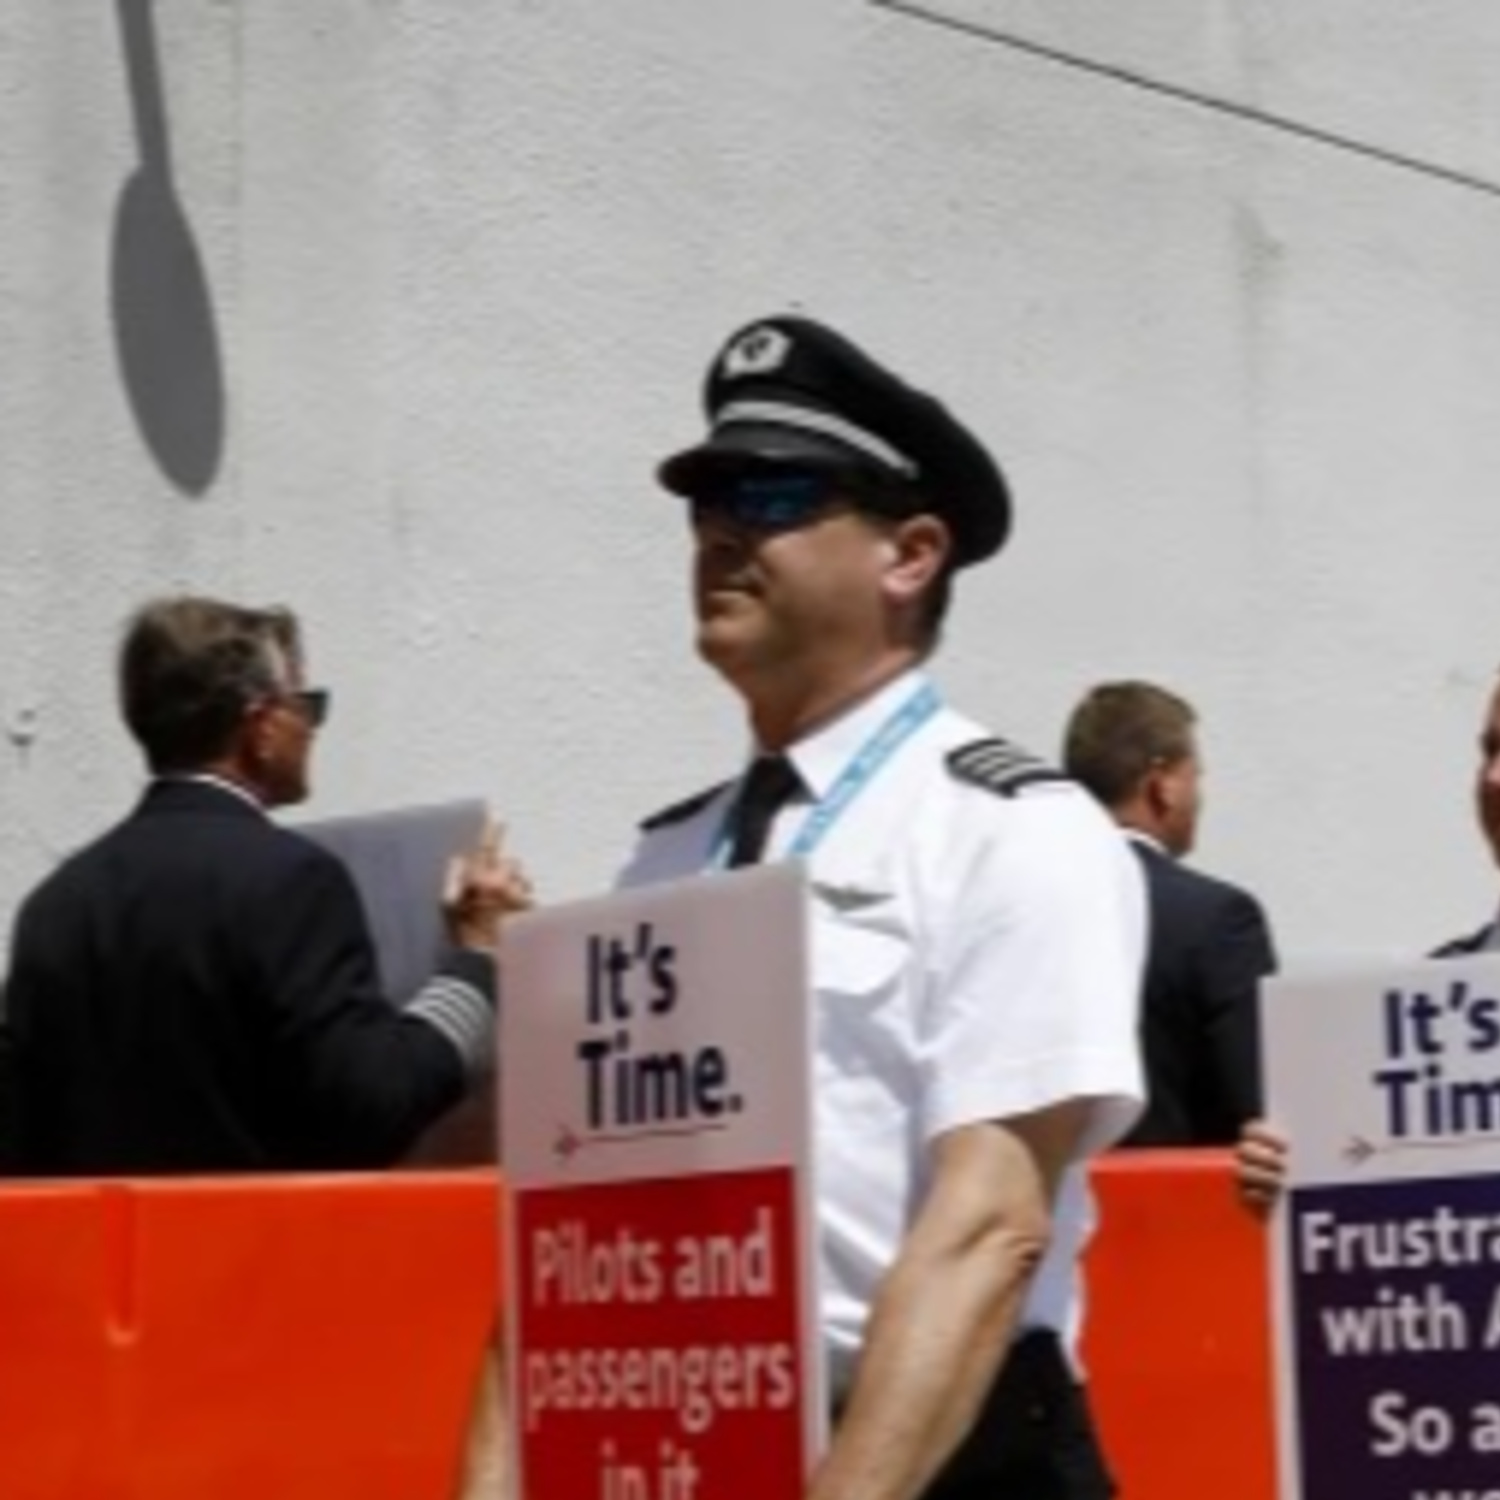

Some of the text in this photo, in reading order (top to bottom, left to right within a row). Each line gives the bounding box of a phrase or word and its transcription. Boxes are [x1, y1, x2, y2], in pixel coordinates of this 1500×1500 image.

[586, 922, 677, 1024] It's
[577, 1031, 743, 1131] Time.
[533, 1207, 774, 1304] Pilots and
[1322, 1285, 1466, 1355] with
[526, 1341, 795, 1434] passengers
[1369, 1393, 1451, 1457] So
